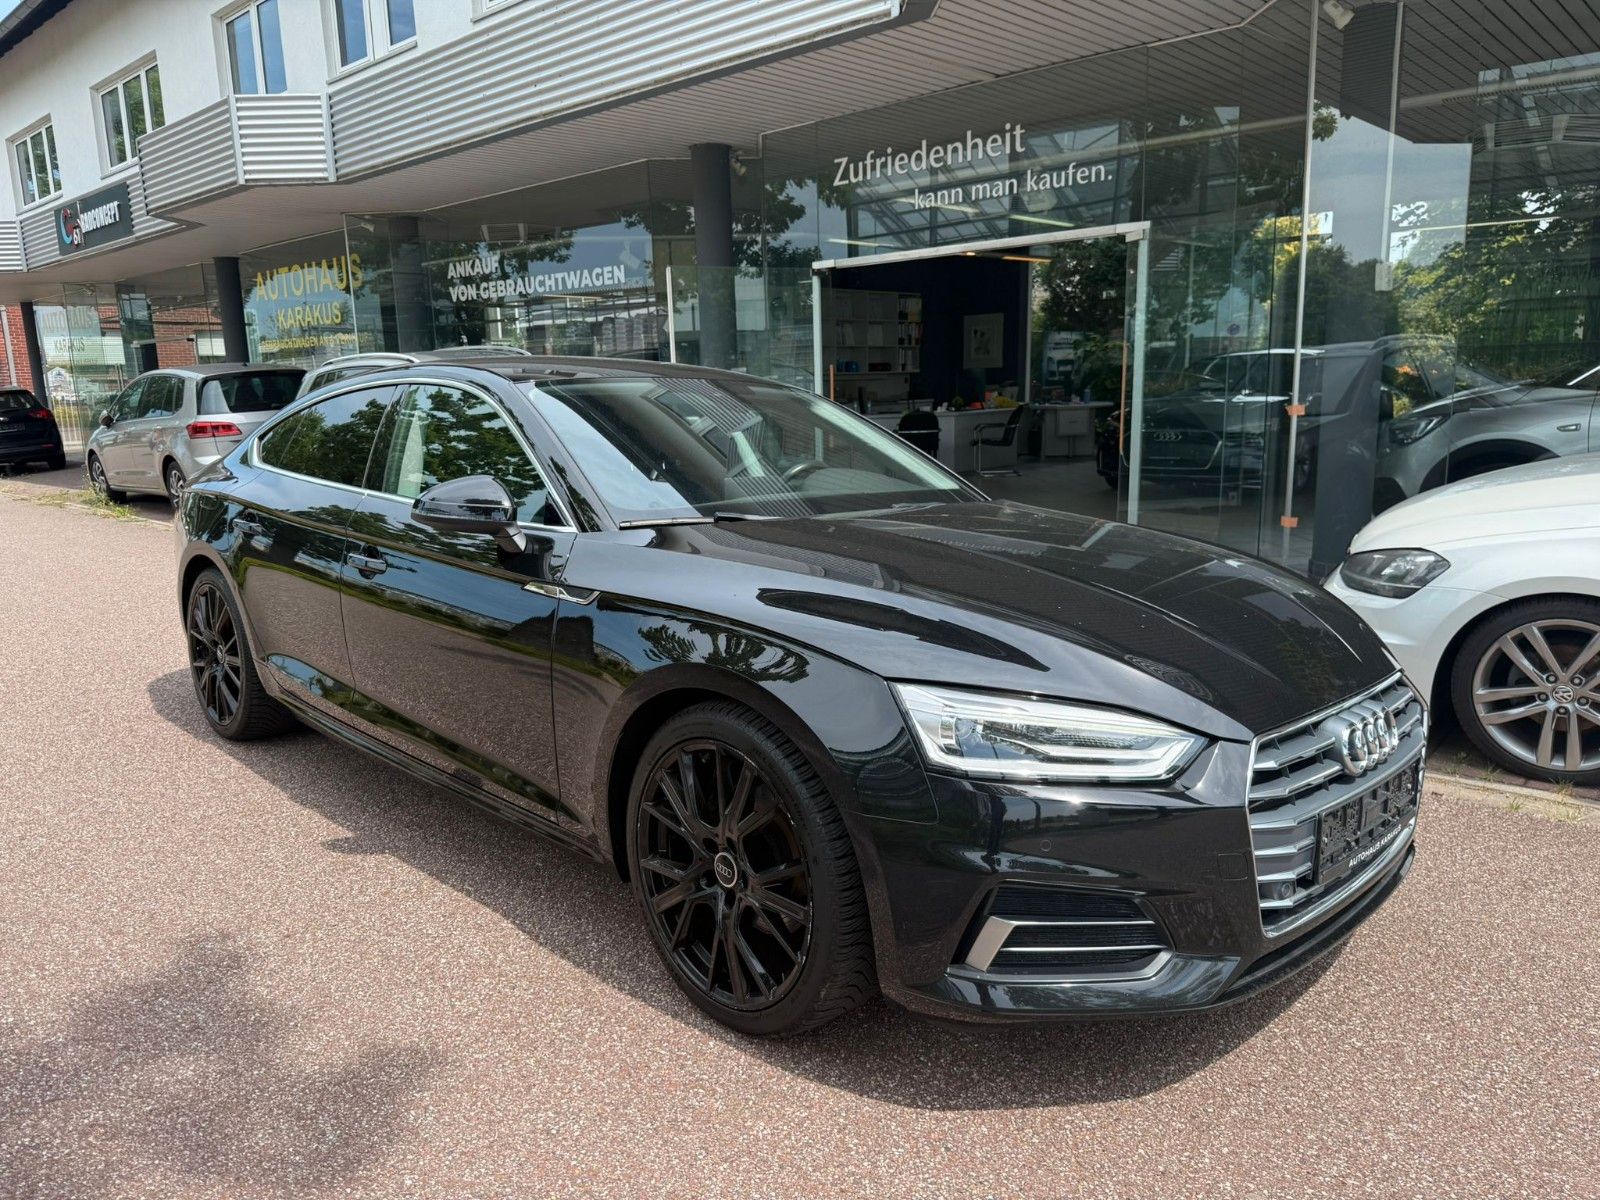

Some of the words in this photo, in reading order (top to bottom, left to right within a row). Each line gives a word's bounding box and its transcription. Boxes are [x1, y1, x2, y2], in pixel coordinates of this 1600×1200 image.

[833, 122, 1026, 187] Zufriedenheit
[914, 188, 963, 210] kann
[971, 177, 1018, 202] man
[1027, 161, 1113, 193] kaufen.
[256, 253, 363, 302] AUTOHAUS
[447, 255, 500, 280] ANKAUF
[450, 284, 477, 303] VON
[479, 264, 627, 300] GEBRAUCHTWAGEN
[277, 301, 342, 330] KARAKUS
[1348, 841, 1381, 868] AUTOHAUS
